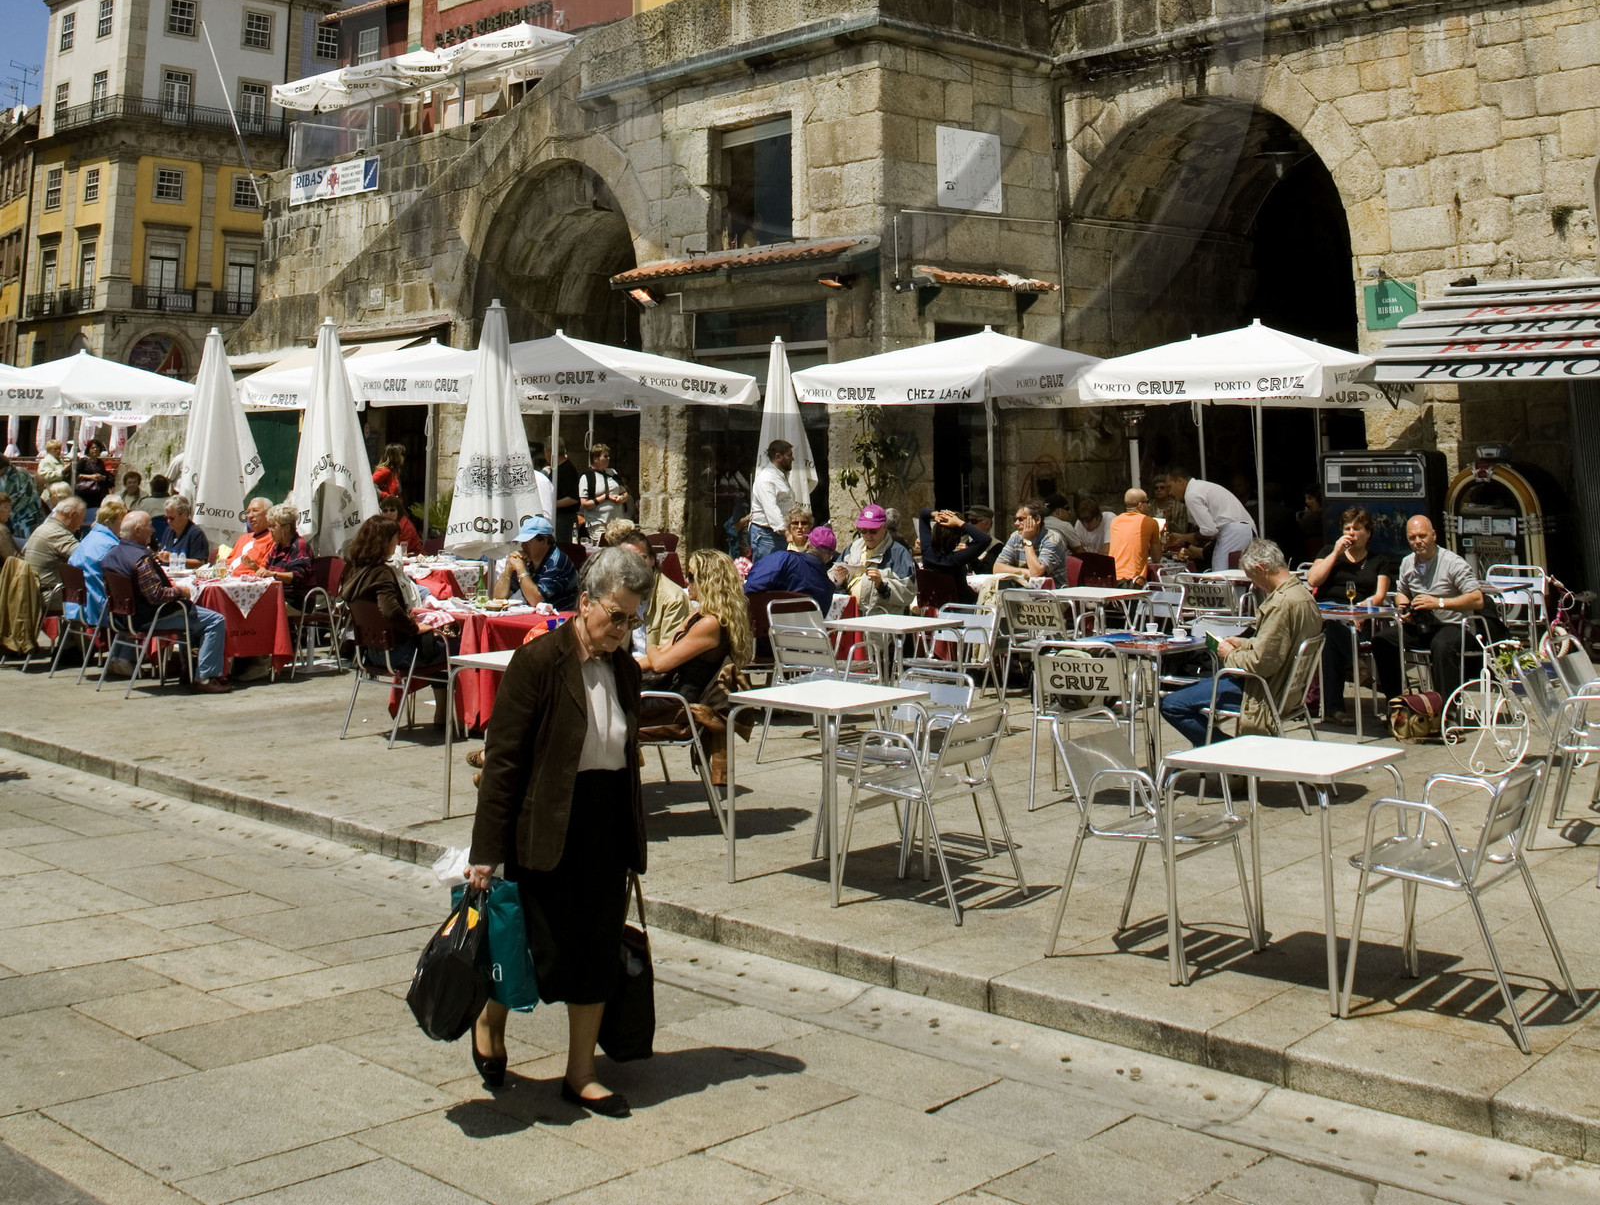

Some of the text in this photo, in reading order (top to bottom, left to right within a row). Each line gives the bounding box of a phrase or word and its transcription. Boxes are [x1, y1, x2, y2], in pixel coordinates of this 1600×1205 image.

[501, 40, 525, 49] CRUZ
[418, 65, 442, 73] CRUZ
[294, 84, 311, 94] CRUZ
[347, 82, 370, 90] CRUZ
[1377, 305, 1404, 315] RIBEIRA
[521, 370, 595, 386] PORTO CRUZ
[1016, 374, 1064, 389] PORTO CRUZ
[1214, 376, 1305, 392] PORTO CRUZ
[363, 378, 407, 392] PORTO CRUZ
[414, 378, 459, 392] PORTO CRUZ
[650, 377, 717, 395] PORTO CRUZ
[1093, 380, 1186, 395] PORTO CRUZ
[7, 388, 44, 400] CRUZ
[270, 393, 298, 405] CRUZ
[836, 387, 876, 401] CRUZ
[907, 388, 935, 401] CHEZ
[97, 400, 133, 411] CRUZ
[446, 521, 473, 536] ORTO
[1187, 584, 1222, 595] PORTO
[1017, 603, 1051, 613] PORTO
[1186, 595, 1226, 608] CRUZ
[1016, 613, 1057, 628] CRUZ
[1052, 661, 1104, 674] PORTO
[1050, 674, 1109, 691] CRUZ
